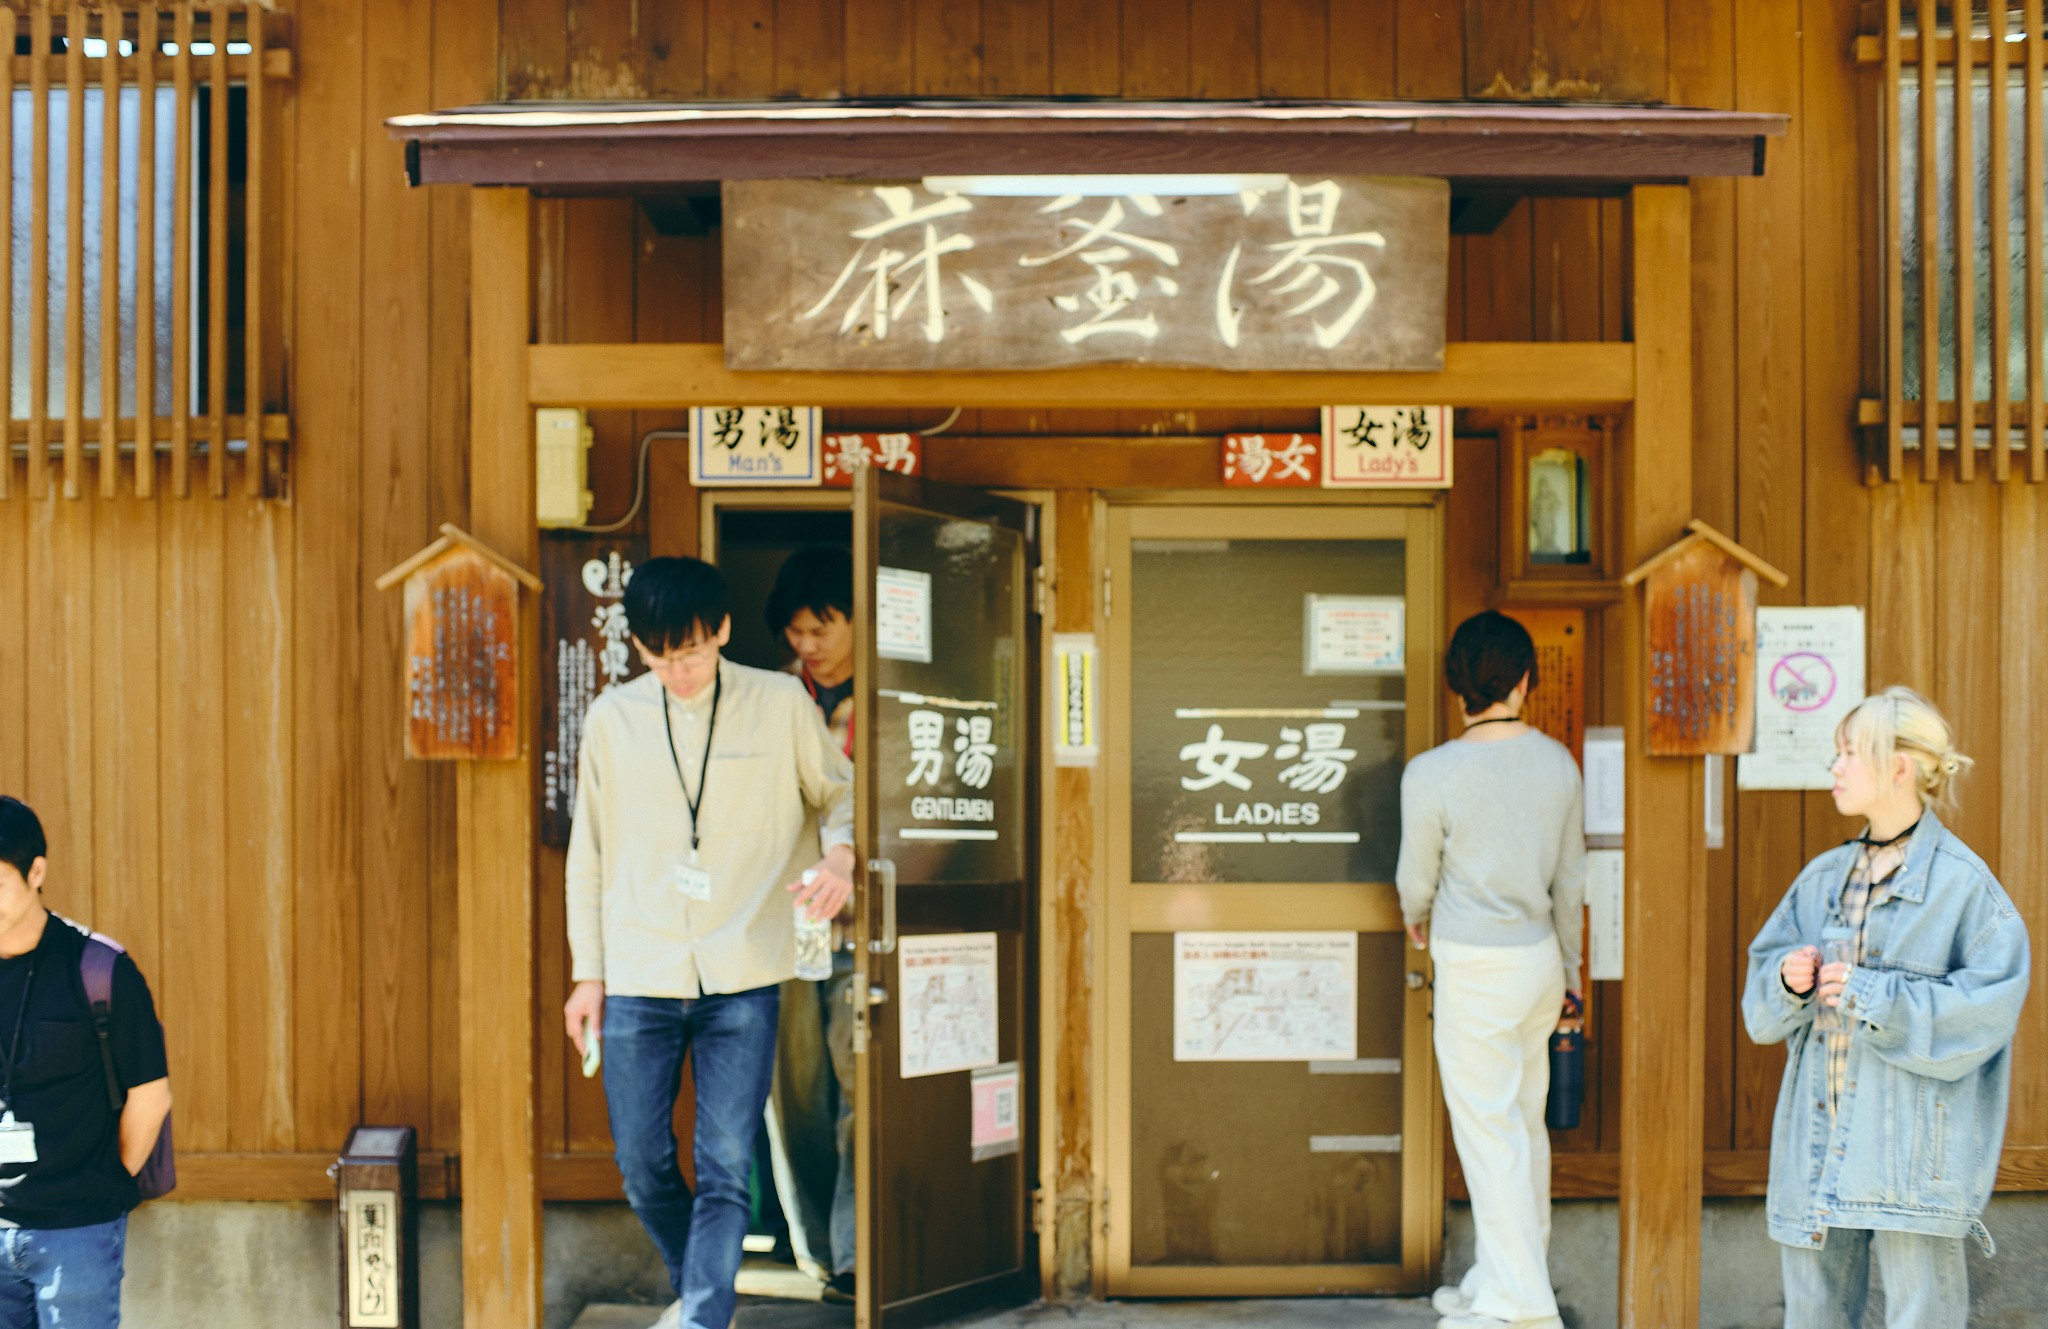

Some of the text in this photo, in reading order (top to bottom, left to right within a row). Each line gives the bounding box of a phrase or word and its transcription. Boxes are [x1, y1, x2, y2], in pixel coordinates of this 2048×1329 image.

[712, 407, 799, 450] 男湯
[1341, 407, 1432, 451] 女湯
[728, 453, 783, 472] Man's
[1358, 453, 1428, 478] Lady's
[906, 710, 998, 789] 男湯
[1179, 723, 1358, 794] 女湯
[911, 796, 995, 822] GENTLEMEN
